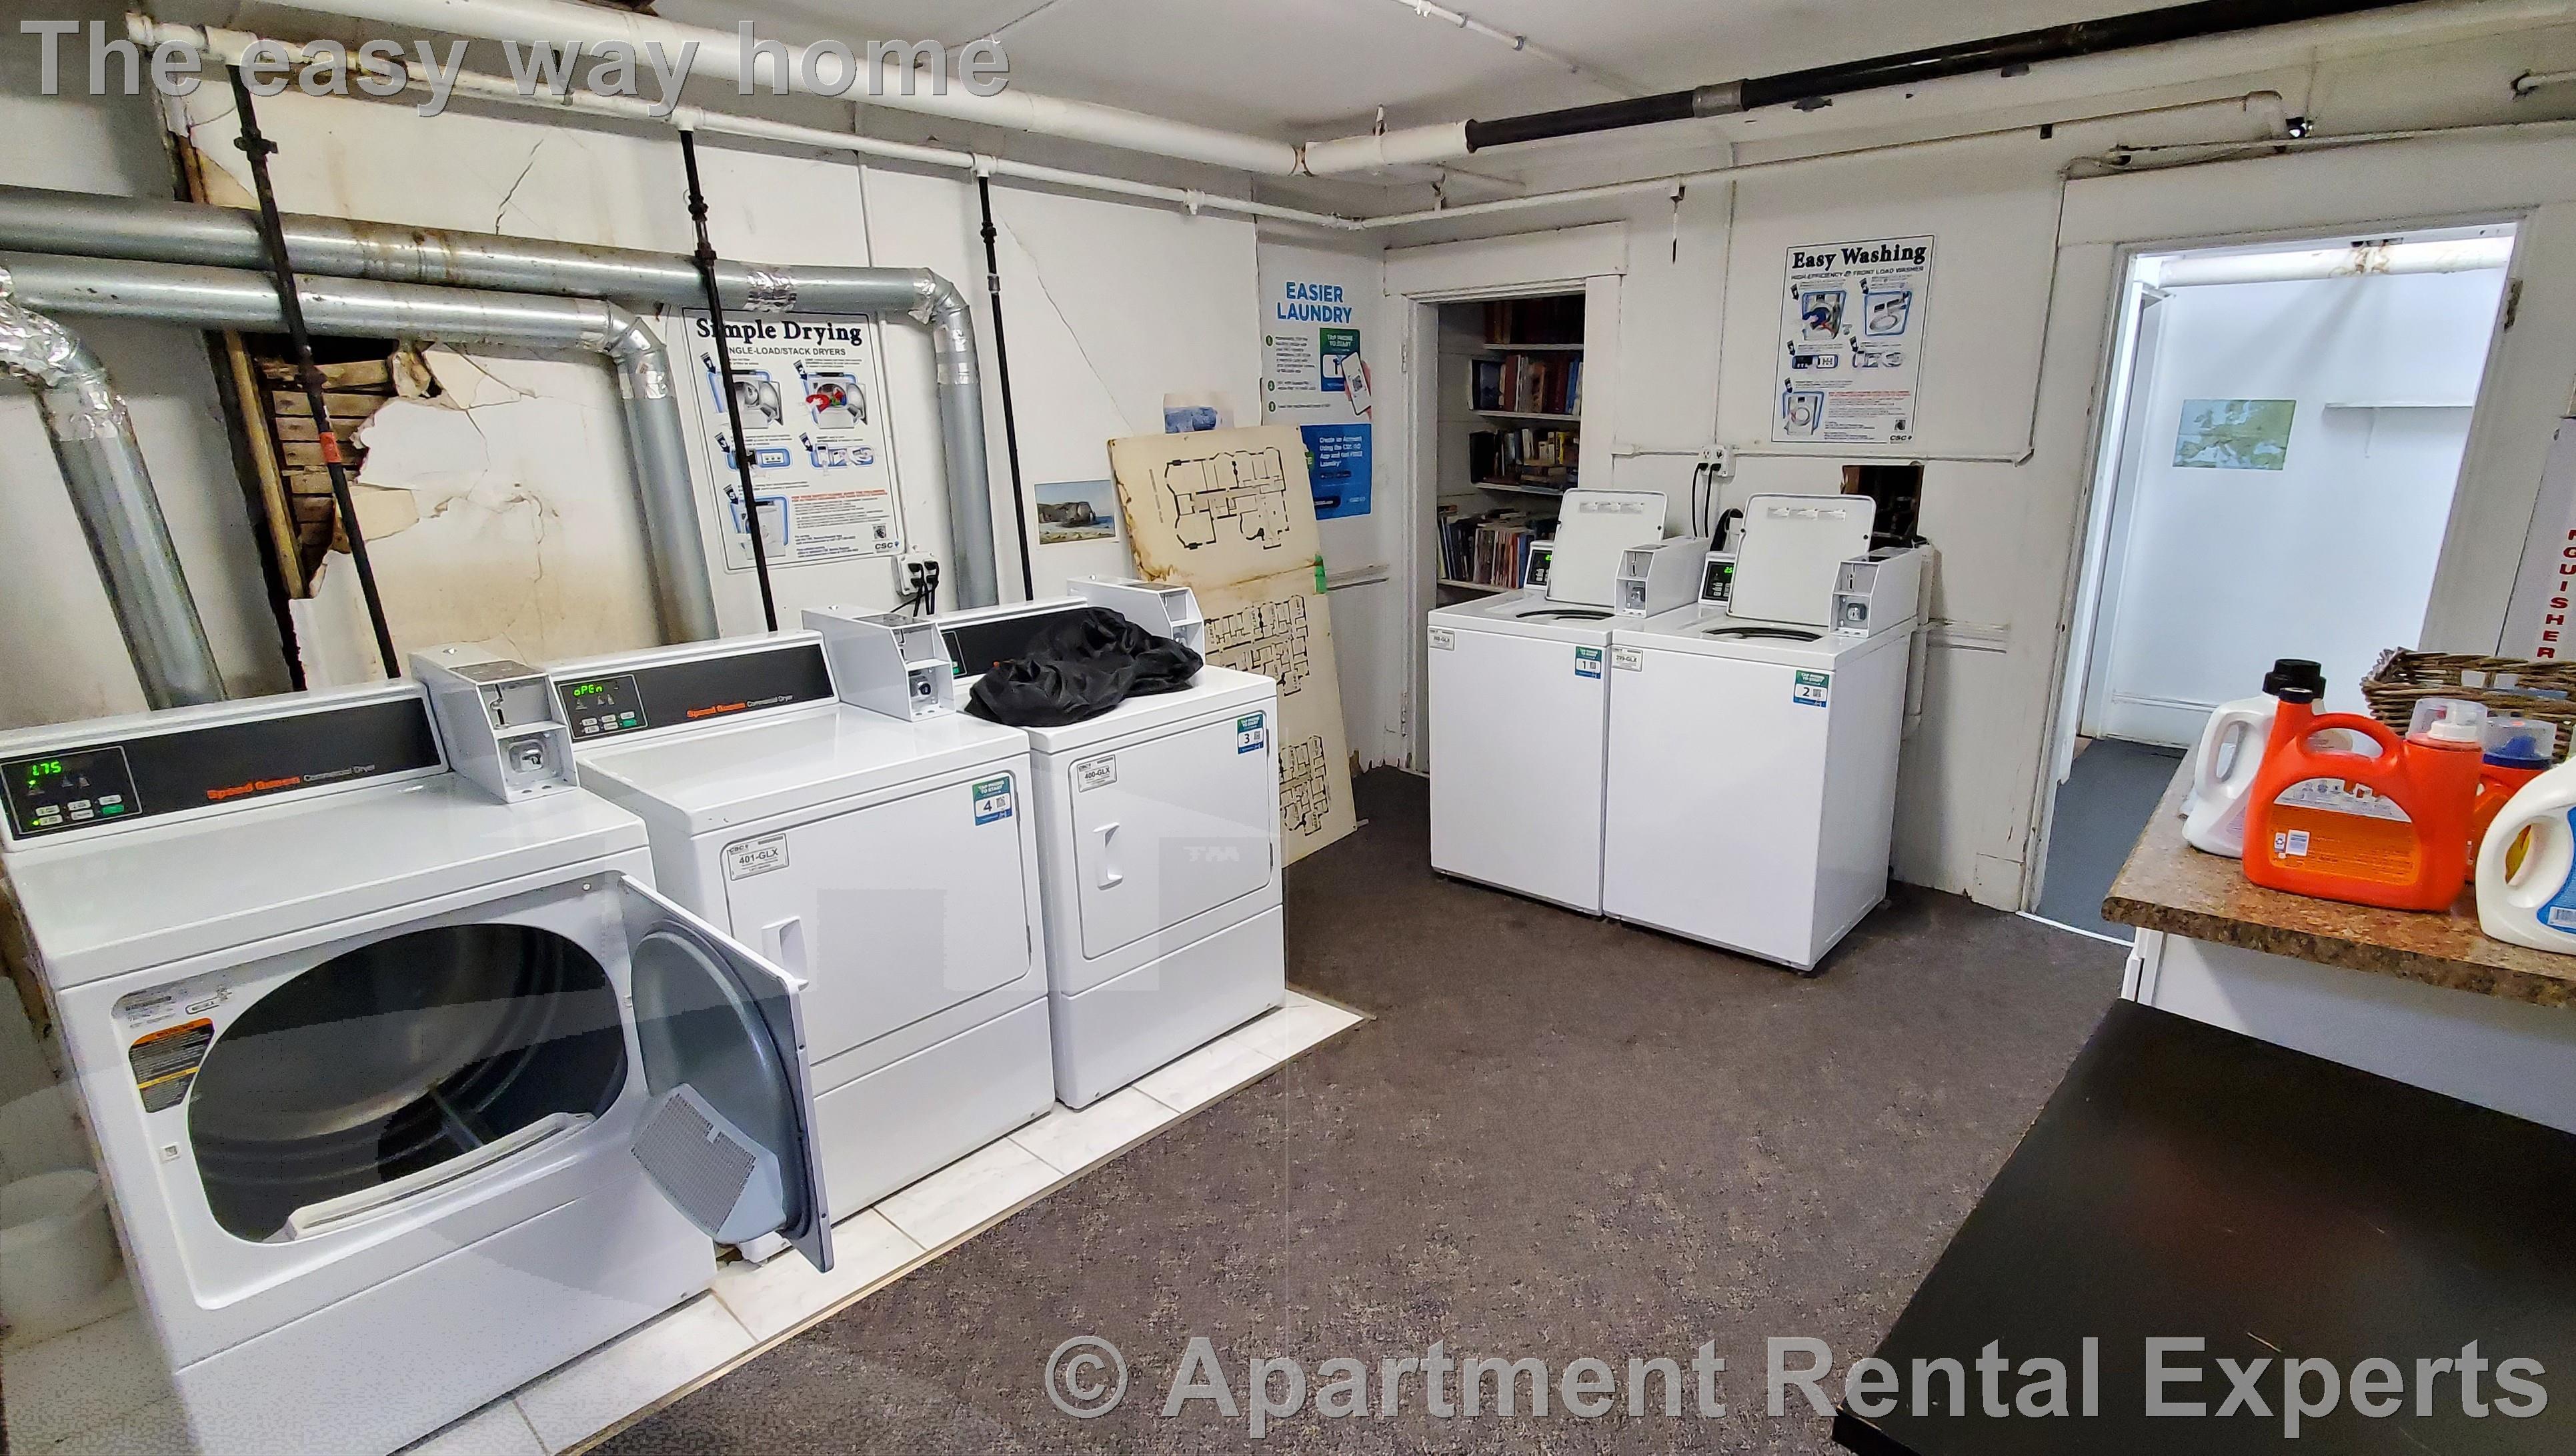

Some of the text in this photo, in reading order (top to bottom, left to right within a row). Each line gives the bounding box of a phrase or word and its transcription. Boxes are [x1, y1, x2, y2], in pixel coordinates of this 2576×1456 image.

[1792, 244, 1927, 271] Easy Washing
[1286, 281, 1343, 303] EASIER
[1277, 302, 1352, 324] LAUNDRY
[781, 320, 863, 347] Drying
[729, 347, 846, 356] NGLE-LOAD/STACK DRYERS
[1582, 661, 1586, 669] 1
[1802, 687, 1810, 697] 2
[1244, 733, 1250, 744] 3
[1085, 767, 1110, 779] 400-GLX
[983, 800, 992, 811] 4
[739, 848, 779, 864] 401-GLX
